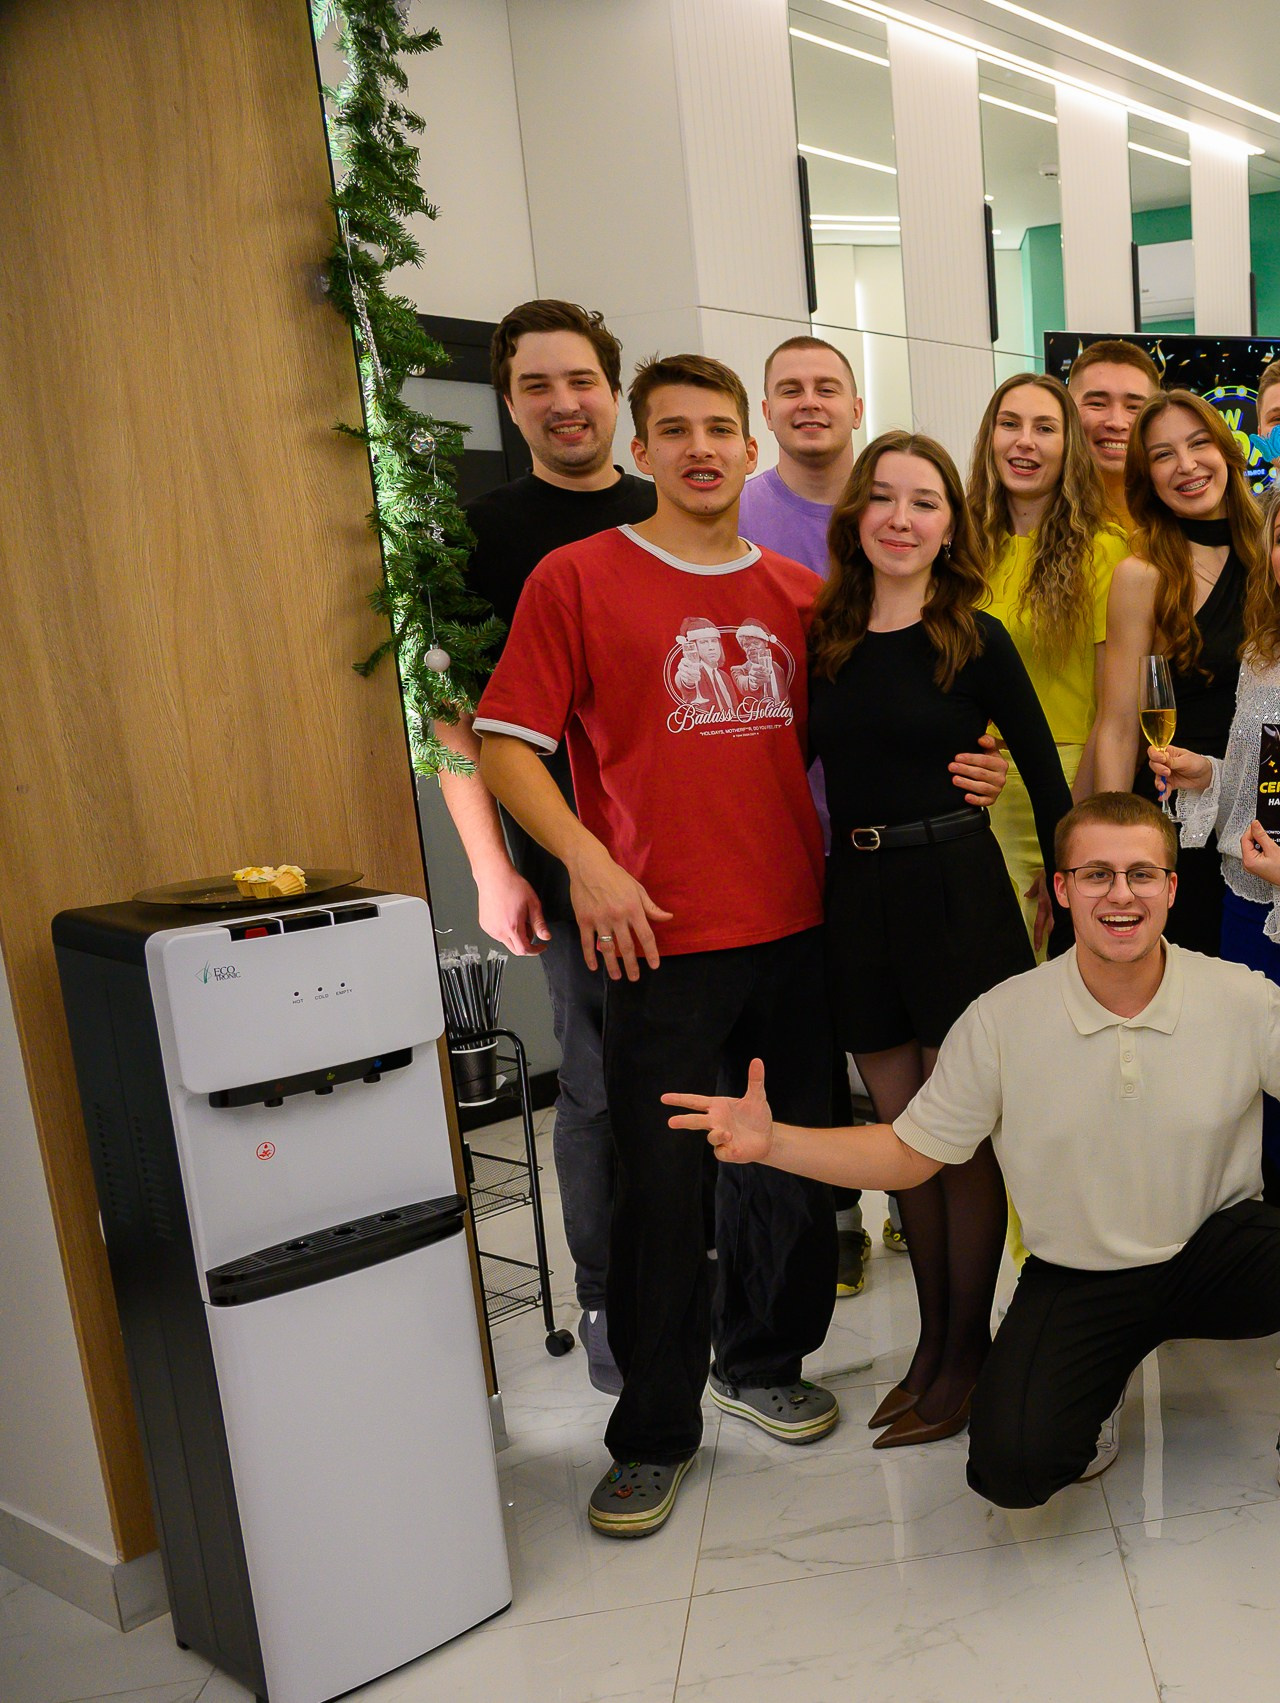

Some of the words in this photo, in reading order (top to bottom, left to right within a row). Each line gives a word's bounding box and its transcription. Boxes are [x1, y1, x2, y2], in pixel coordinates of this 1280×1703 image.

[667, 703, 734, 733] Badass
[736, 696, 794, 726] Holiday
[1268, 798, 1280, 806] НА
[213, 965, 236, 977] ECO
[215, 971, 242, 982] TRONIC
[335, 988, 353, 996] EMPTY
[314, 993, 330, 1001] COLD
